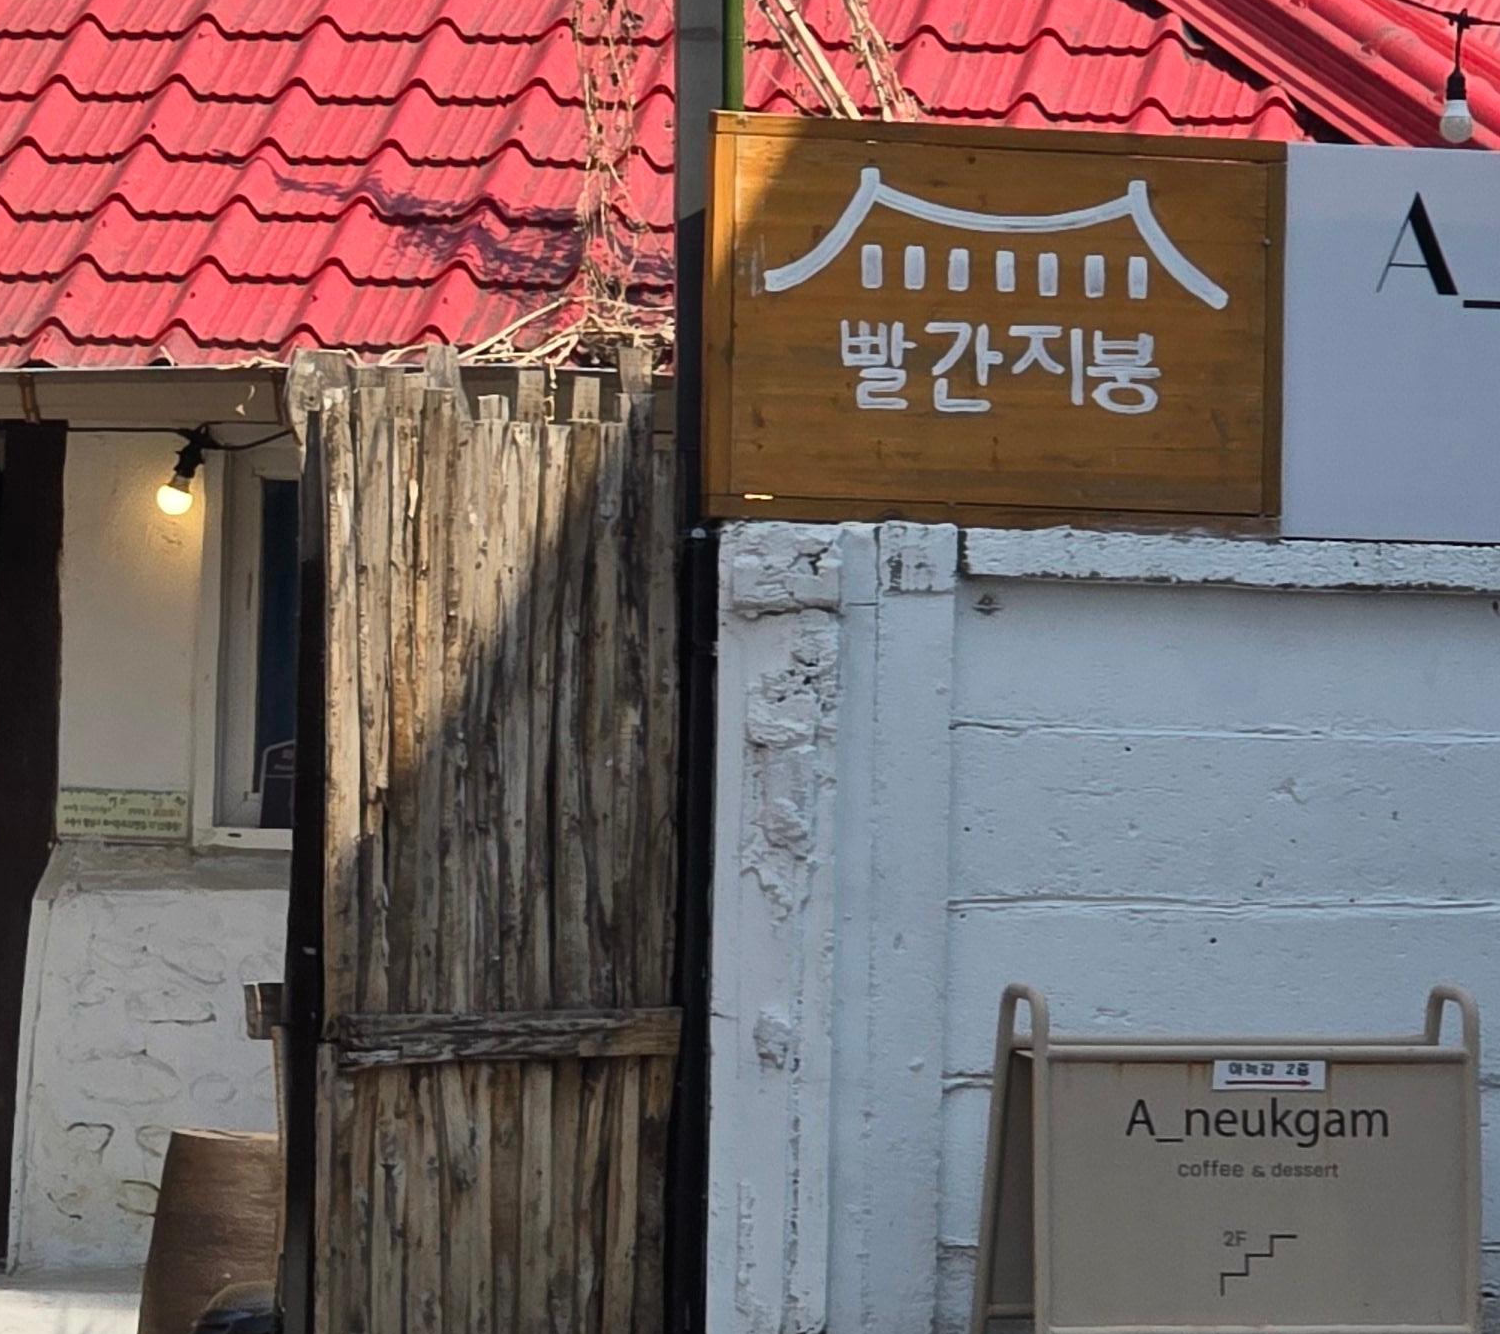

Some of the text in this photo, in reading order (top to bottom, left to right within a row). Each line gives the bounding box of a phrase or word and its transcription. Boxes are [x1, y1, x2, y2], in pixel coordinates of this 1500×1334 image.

[840, 319, 1161, 414] 빨간지붕
[1125, 1097, 1390, 1149] A_neukgam
[1177, 1159, 1339, 1179] coffee & dessert
[1222, 1230, 1248, 1248] 2F
